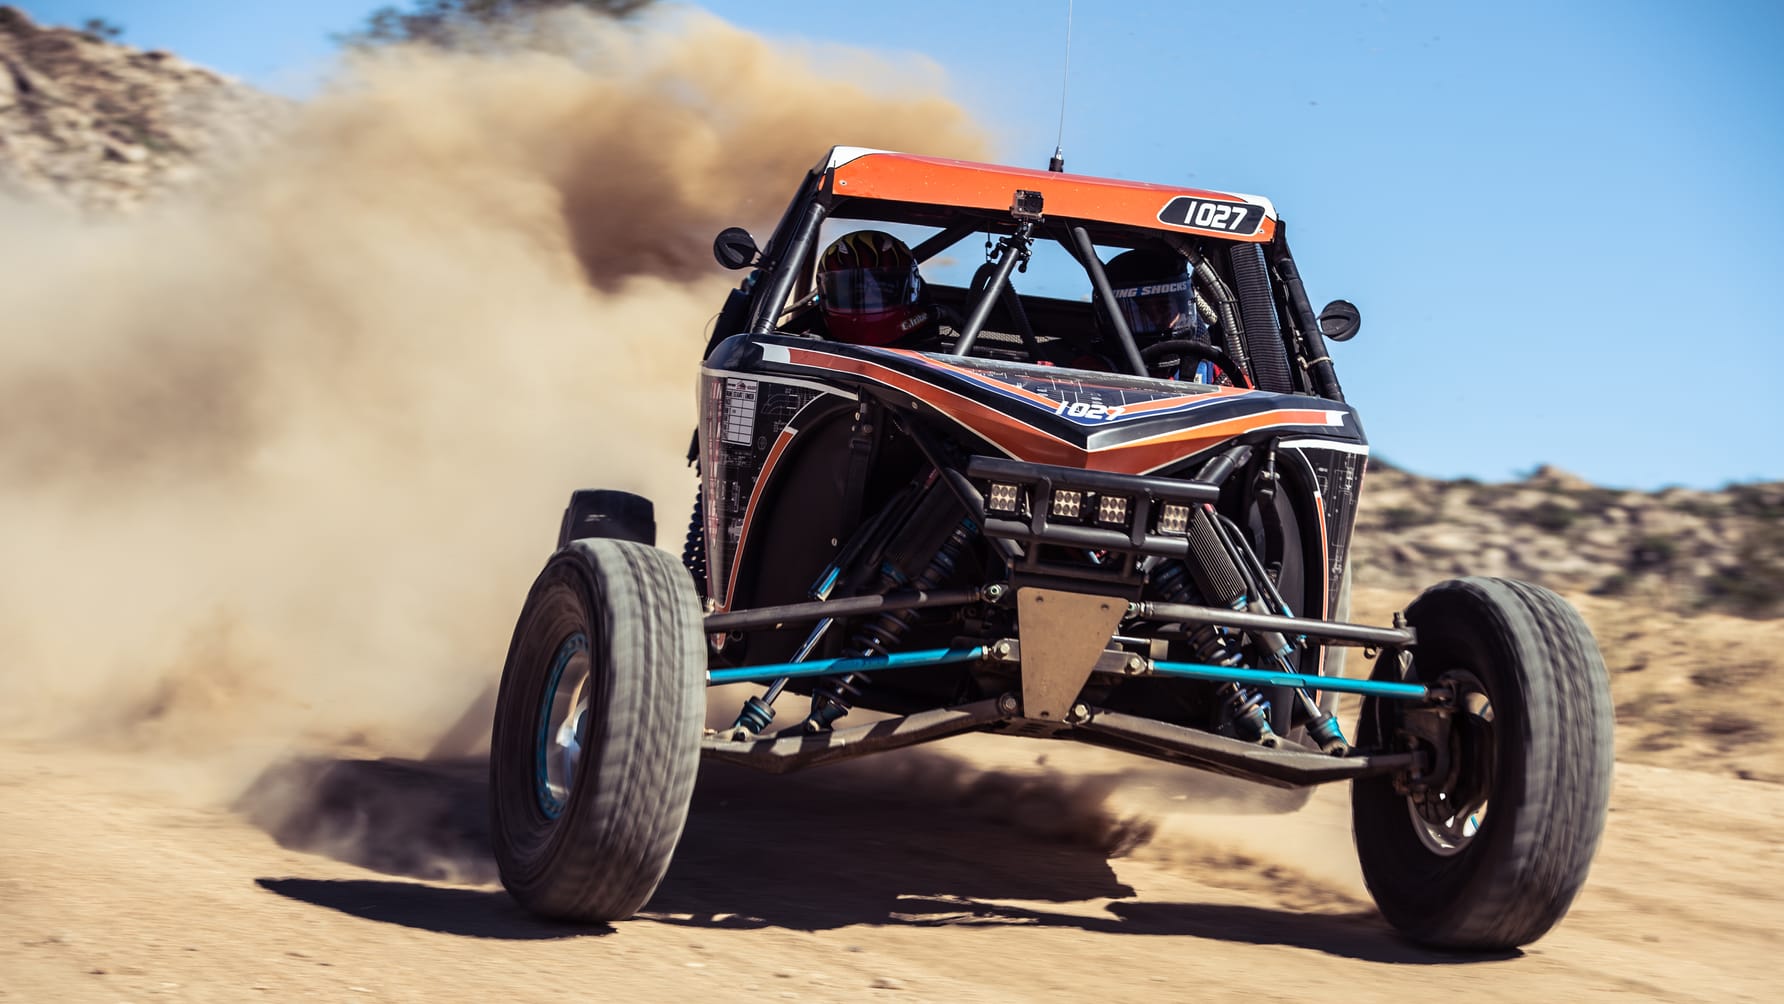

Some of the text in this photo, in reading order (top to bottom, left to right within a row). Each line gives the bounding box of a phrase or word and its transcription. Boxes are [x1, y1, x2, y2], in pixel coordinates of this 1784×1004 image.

[1184, 201, 1247, 230] 1027
[1141, 281, 1187, 296] SHOCKS
[1055, 400, 1126, 421] 1027
